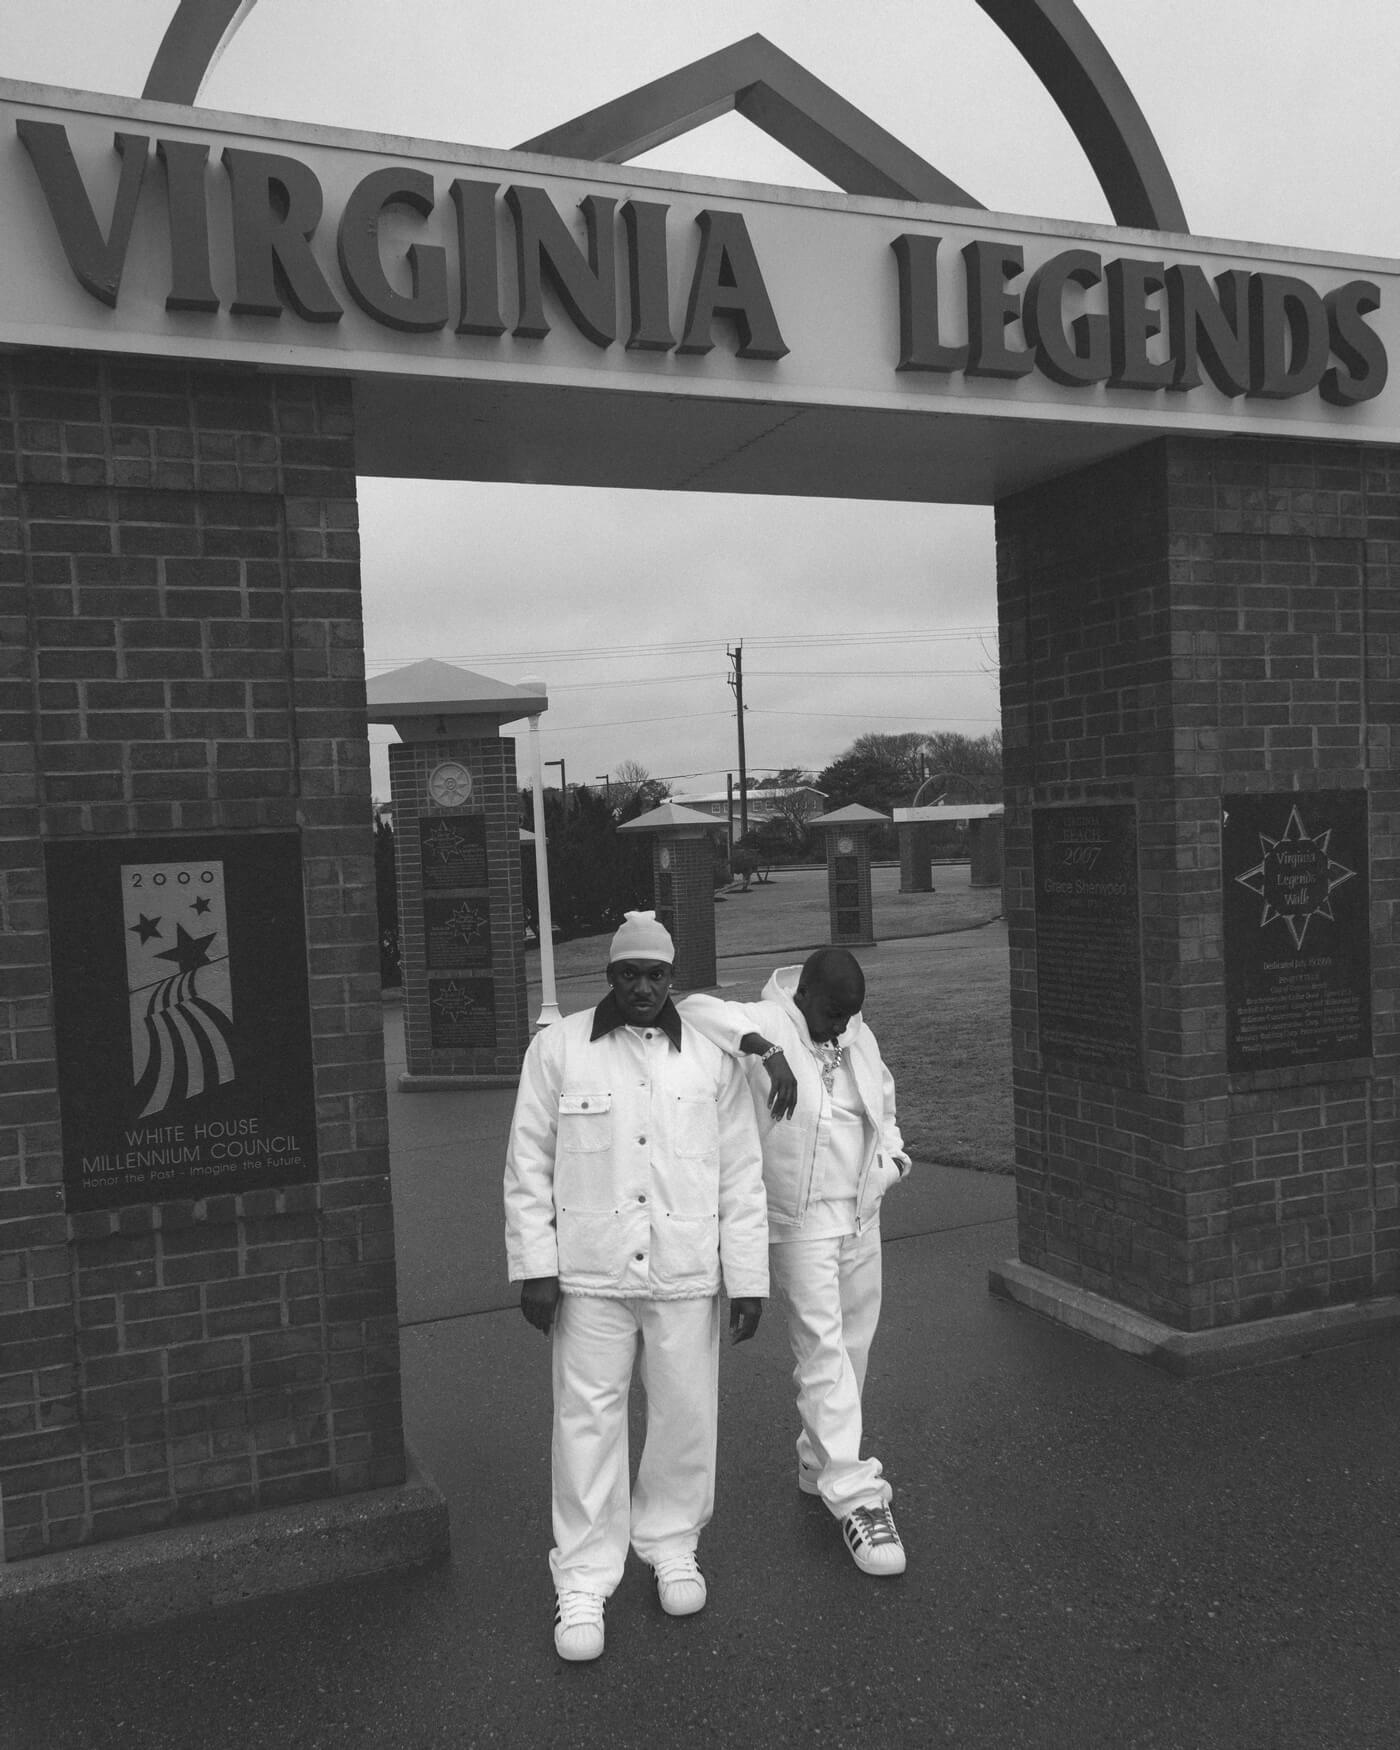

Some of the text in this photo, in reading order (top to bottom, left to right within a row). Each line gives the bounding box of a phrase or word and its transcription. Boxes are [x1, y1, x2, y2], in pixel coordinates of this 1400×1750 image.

[16, 118, 1388, 407] VIRGINIA LEGENDS
[131, 870, 214, 888] 2000
[125, 1117, 259, 1147] WHITE HOUSE
[82, 1135, 301, 1174] MILLENNIUM COUNCIL
[82, 1175, 119, 1189] Honor
[125, 1173, 145, 1183] the
[150, 1168, 176, 1180] Past
[190, 1162, 237, 1177] Imagine
[243, 1158, 262, 1169] the
